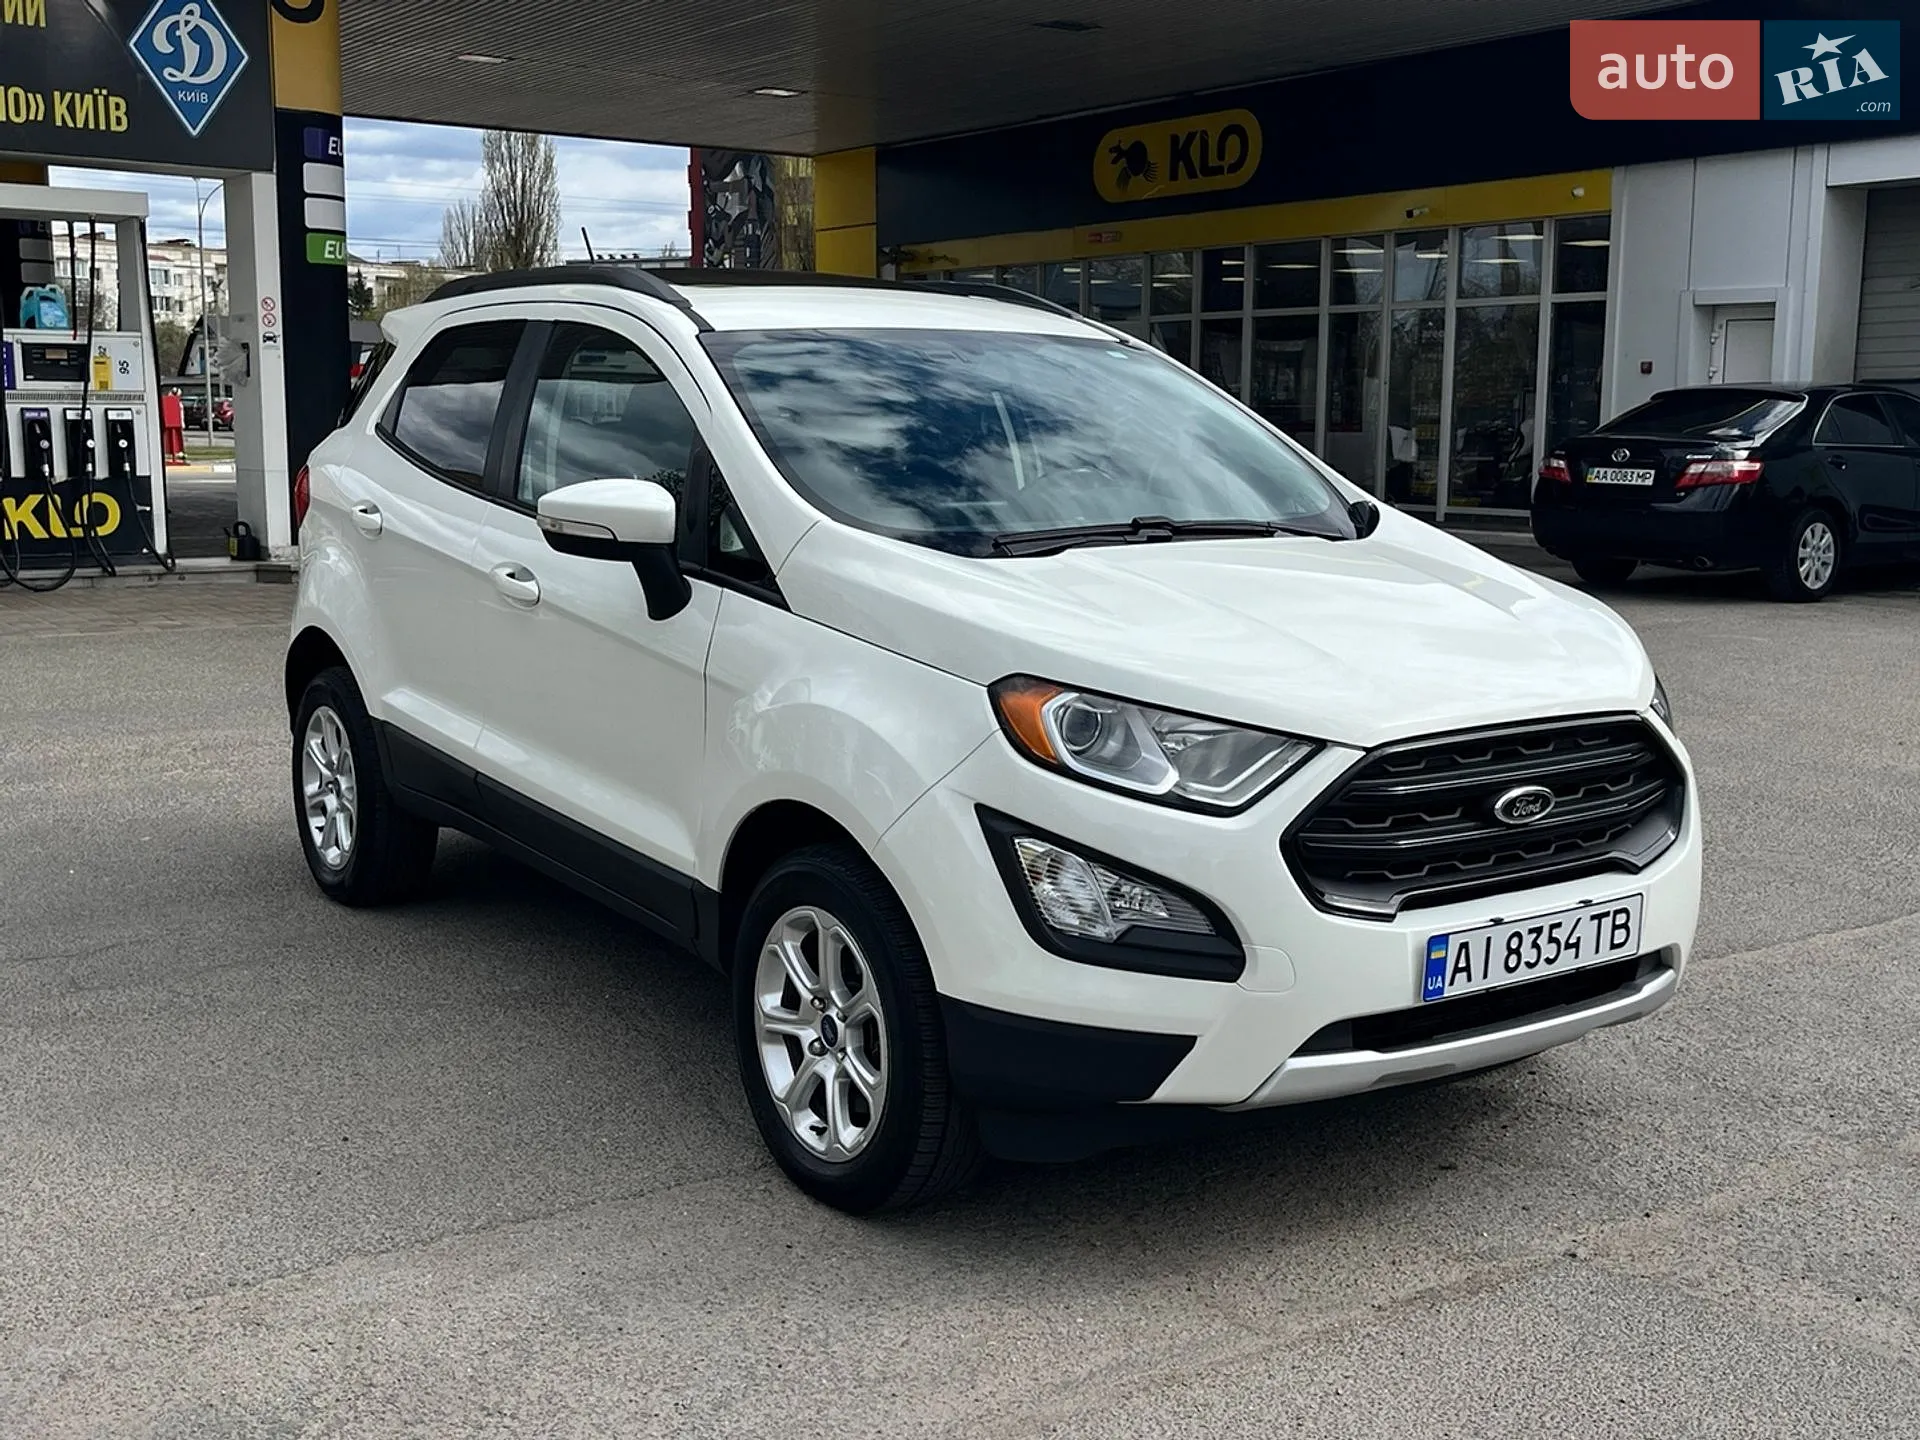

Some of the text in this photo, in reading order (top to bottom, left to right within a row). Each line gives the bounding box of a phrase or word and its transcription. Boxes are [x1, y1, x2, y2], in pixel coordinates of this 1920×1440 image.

[53, 87, 129, 132] КИЇВ
[178, 89, 209, 104] КИЇВ
[1169, 124, 1249, 181] KLO
[118, 359, 130, 375] 95
[3, 491, 121, 541] KLO
[1512, 795, 1543, 817] Ford
[1448, 906, 1632, 988] AI 8354 TB
[1427, 974, 1444, 991] UA
